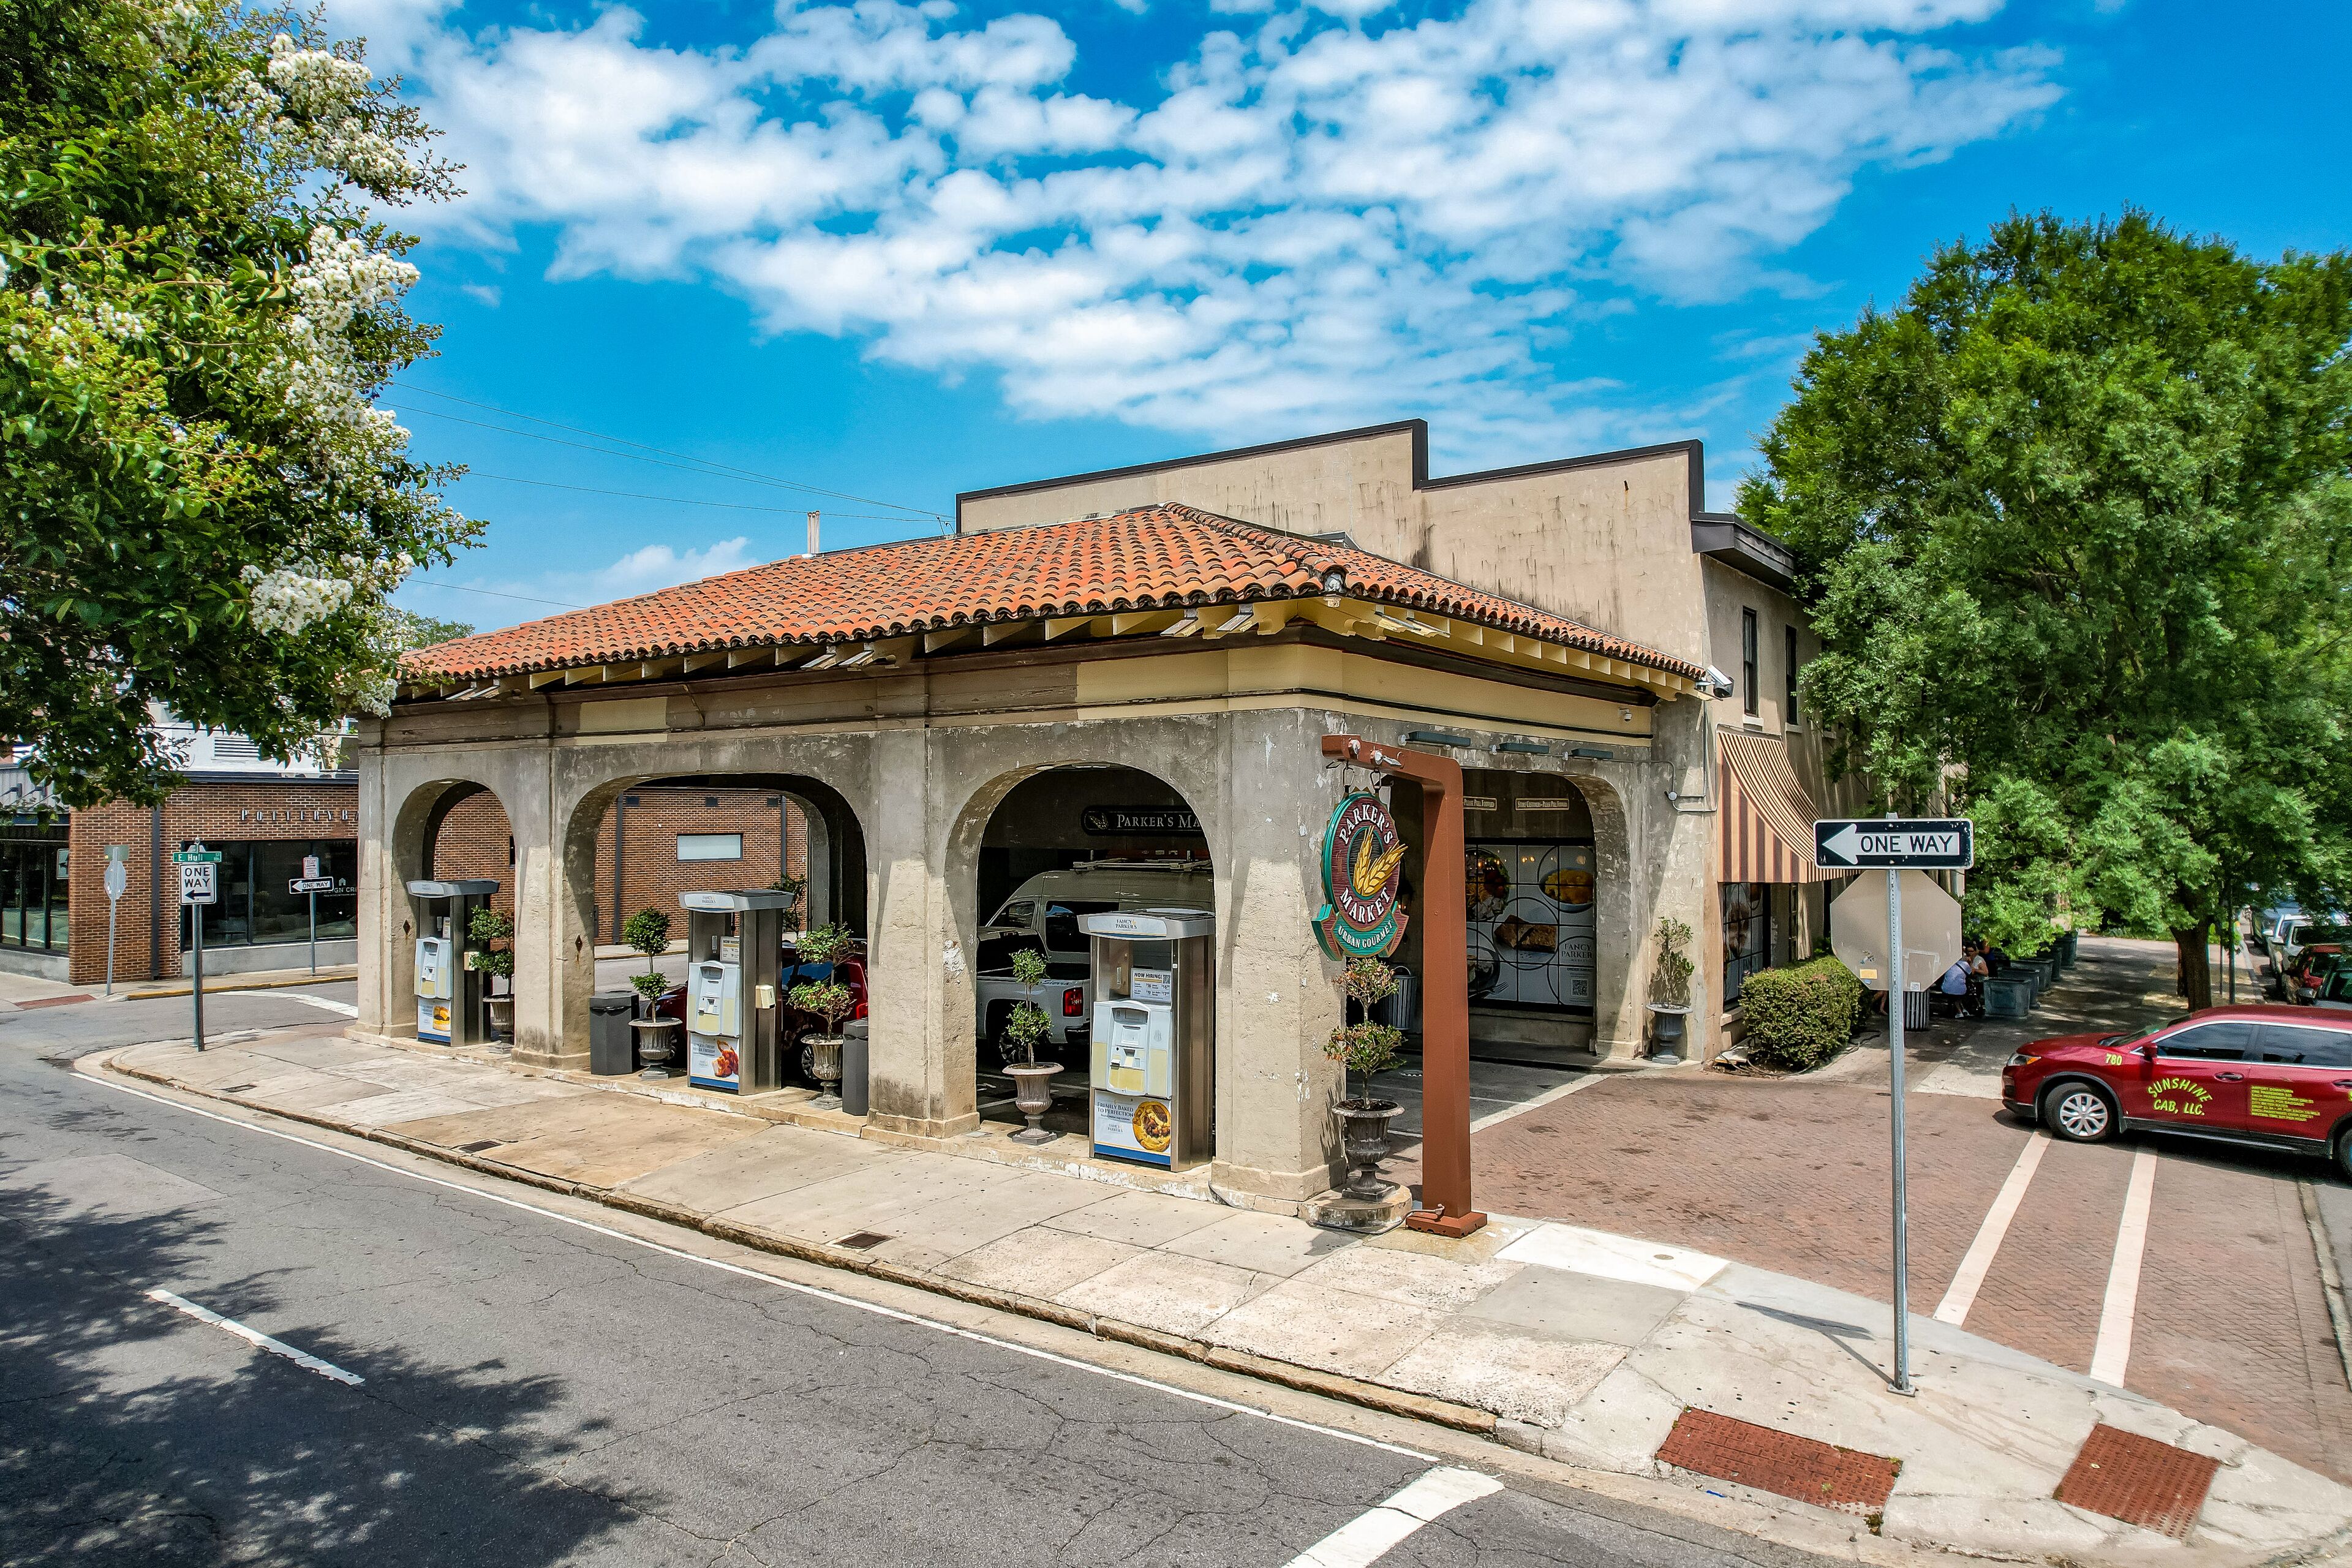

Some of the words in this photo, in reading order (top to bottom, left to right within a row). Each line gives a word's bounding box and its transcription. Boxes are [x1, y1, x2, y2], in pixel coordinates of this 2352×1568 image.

[1117, 814, 1174, 827] PARKER'S
[1339, 804, 1393, 845] PARKER'S
[1860, 835, 1902, 853] ONE
[1909, 835, 1953, 853] WAY
[178, 853, 185, 862] E.
[184, 867, 210, 876] ONE
[184, 878, 211, 888] WAY
[1340, 888, 1390, 924] MARKET
[1338, 924, 1360, 949] URBAN
[1362, 919, 1393, 949] GOURMET
[2105, 1053, 2123, 1066] 780
[2147, 1077, 2213, 1102] SUNSHINE
[1105, 1108, 1134, 1117] PERFECTION
[2153, 1099, 2179, 1114] CAB,
[2183, 1101, 2206, 1116] LLC.
